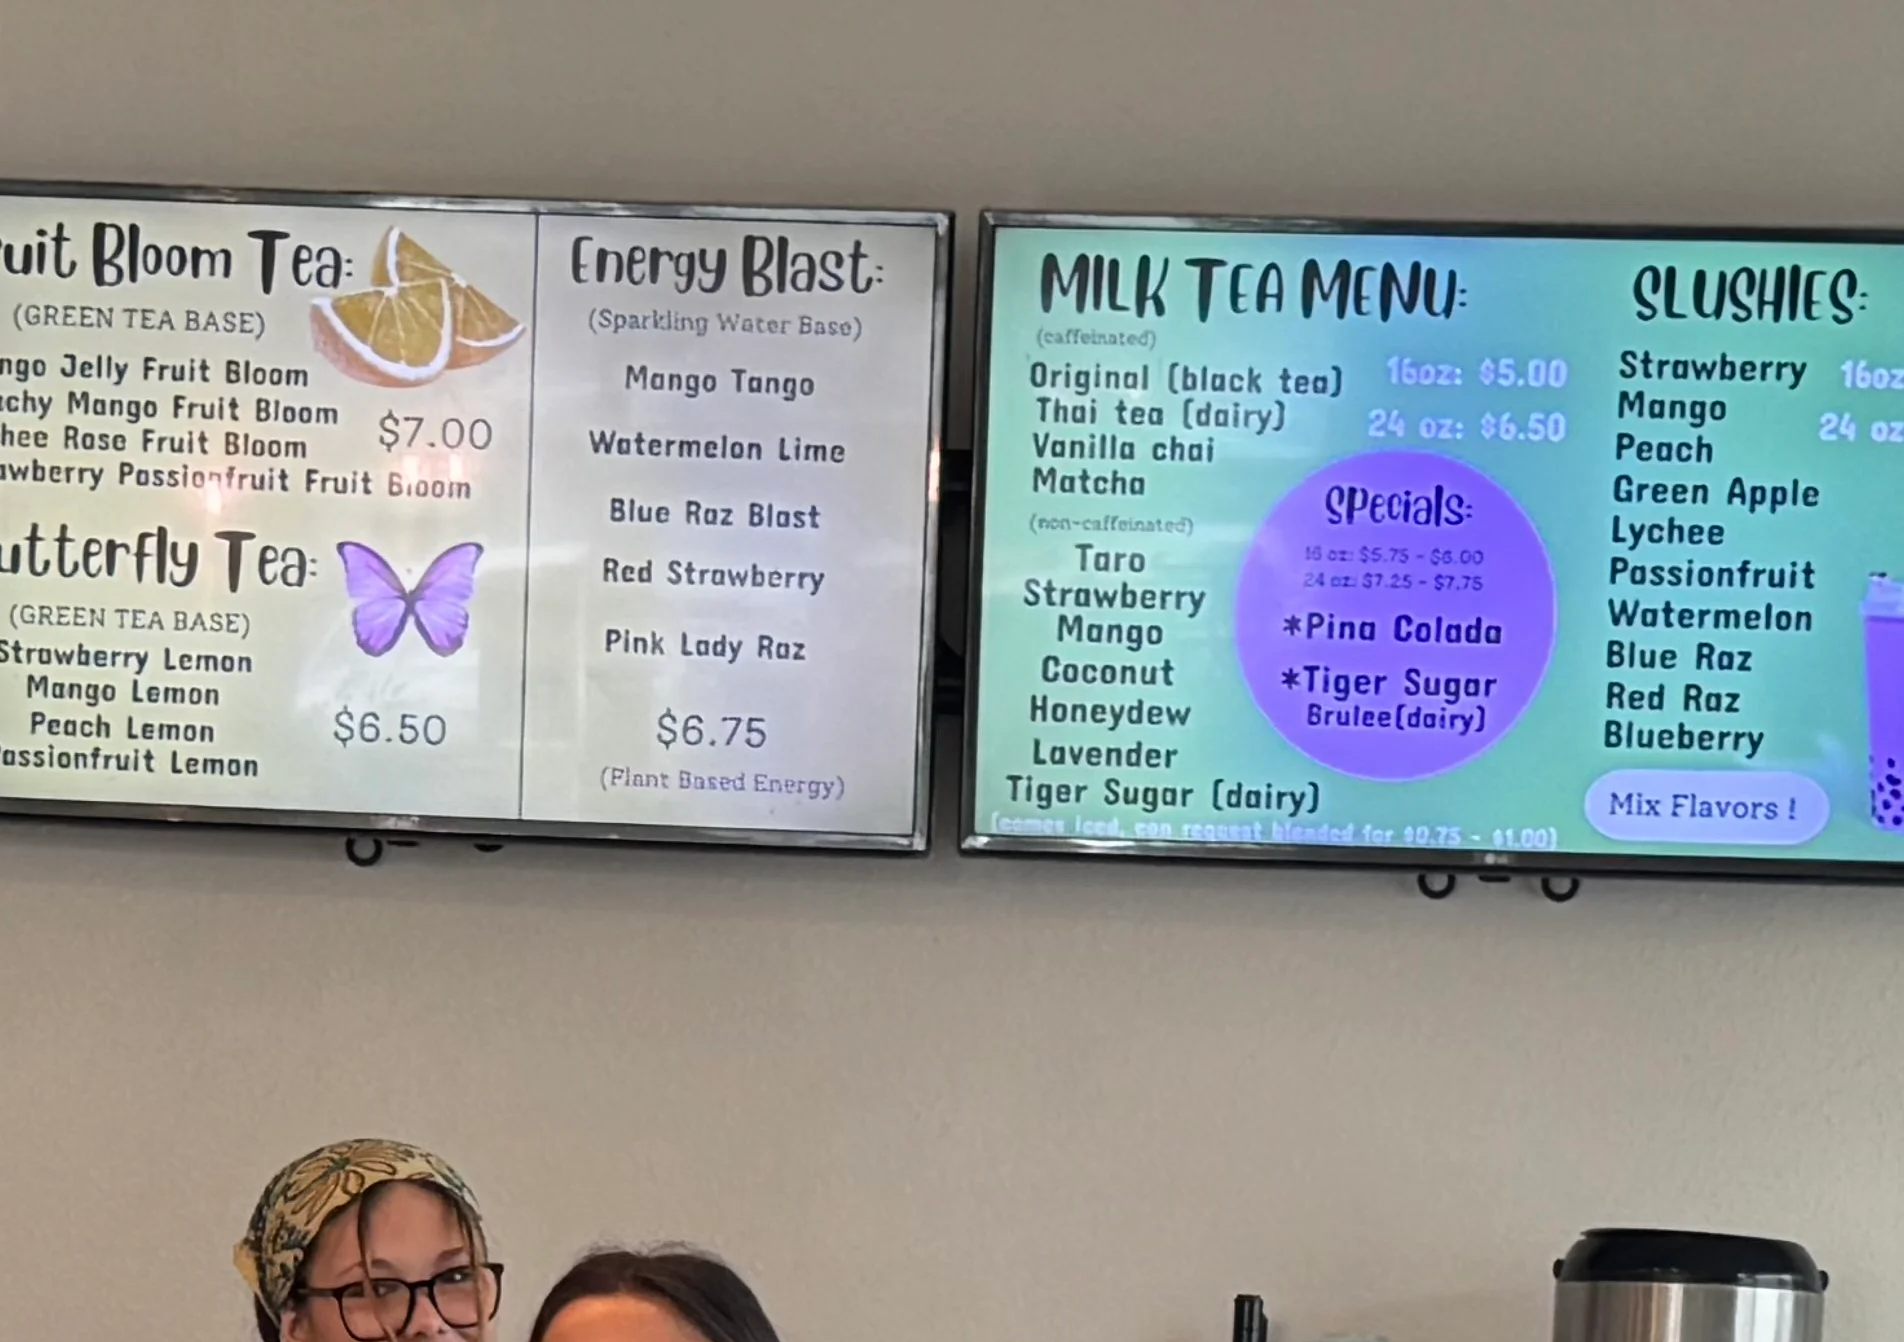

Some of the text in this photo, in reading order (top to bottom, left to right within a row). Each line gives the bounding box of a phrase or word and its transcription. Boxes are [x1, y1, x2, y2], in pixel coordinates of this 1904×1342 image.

[92, 221, 232, 287] Bloom
[246, 229, 353, 295] Tea:
[571, 234, 883, 297] Energy Blast:
[1040, 252, 1467, 323] MILK TEA MENU:
[1633, 264, 1868, 325] SLUSHIES:
[588, 308, 863, 343] (Sparkling Water Base)
[625, 364, 814, 402] Mango Tango
[1030, 361, 1149, 396] Original
[1387, 356, 1568, 388] 16oz: $5.00
[1619, 350, 1807, 391] Strawberry
[379, 409, 493, 453] $7.00
[214, 530, 317, 594] Tea:
[1074, 543, 1146, 573] Taro
[1609, 556, 1816, 590] Passionfruit
[1394, 614, 1502, 645] Colada
[1404, 668, 1498, 705] Sugar
[333, 705, 446, 748] $6.50
[656, 707, 767, 750] $6.75
[1608, 791, 1662, 818] Mix
[1671, 792, 1779, 820] Flavors
